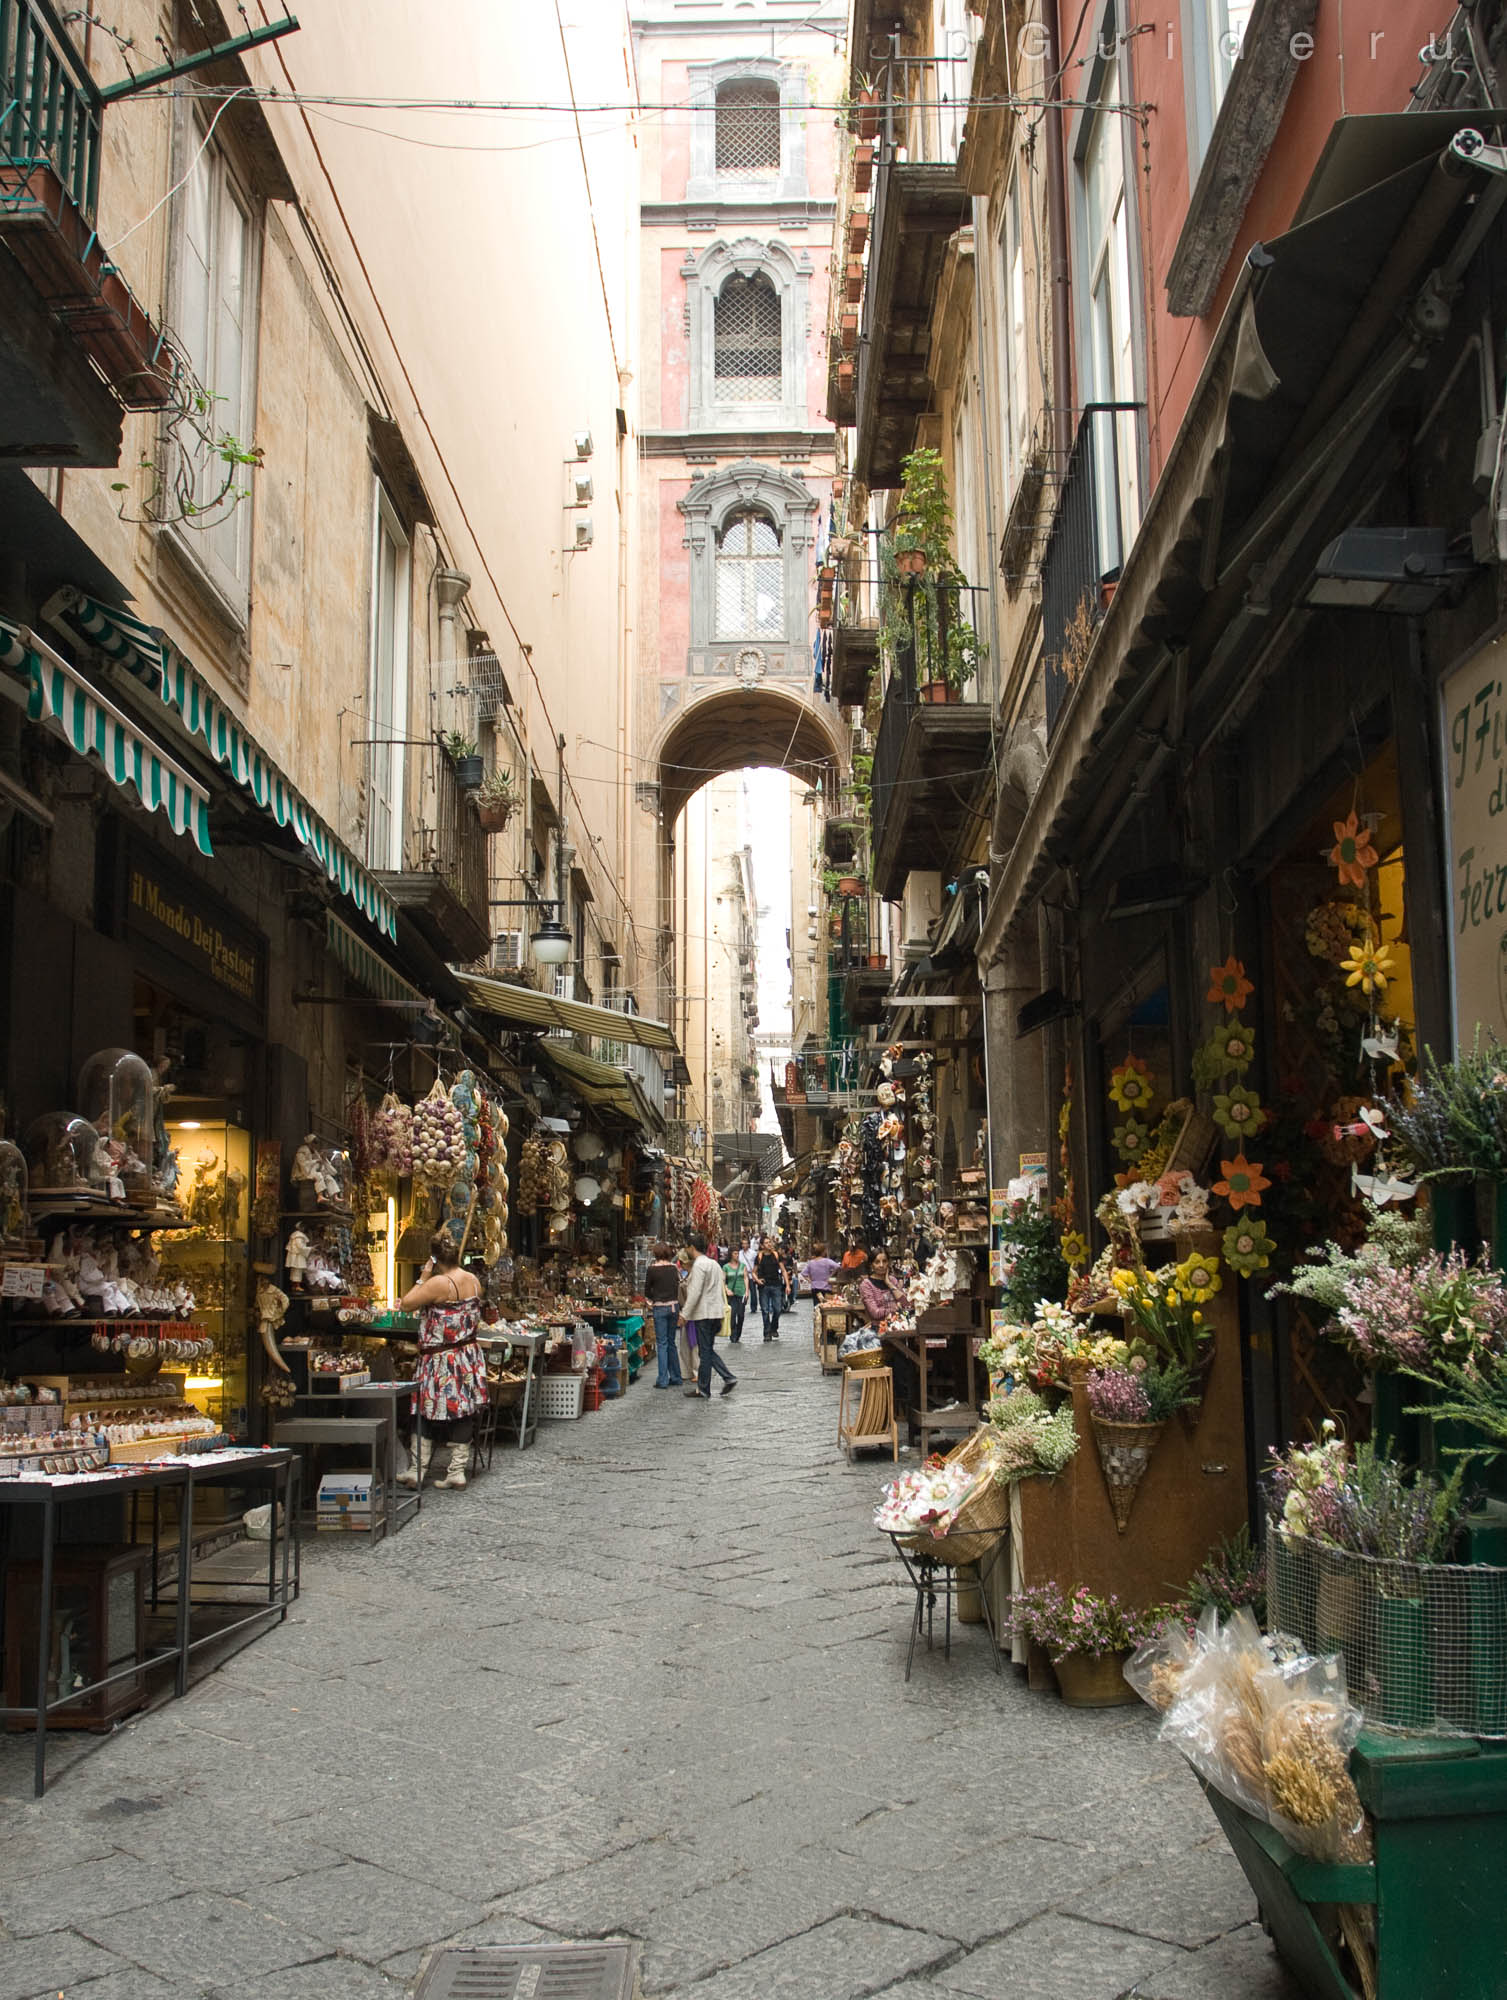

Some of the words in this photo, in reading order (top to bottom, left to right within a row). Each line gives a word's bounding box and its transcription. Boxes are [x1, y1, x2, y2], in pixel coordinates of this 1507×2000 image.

[1474, 680, 1507, 774] Fi
[146, 880, 191, 939] Mondo
[193, 915, 214, 955] Dei
[215, 930, 255, 984] Pastori
